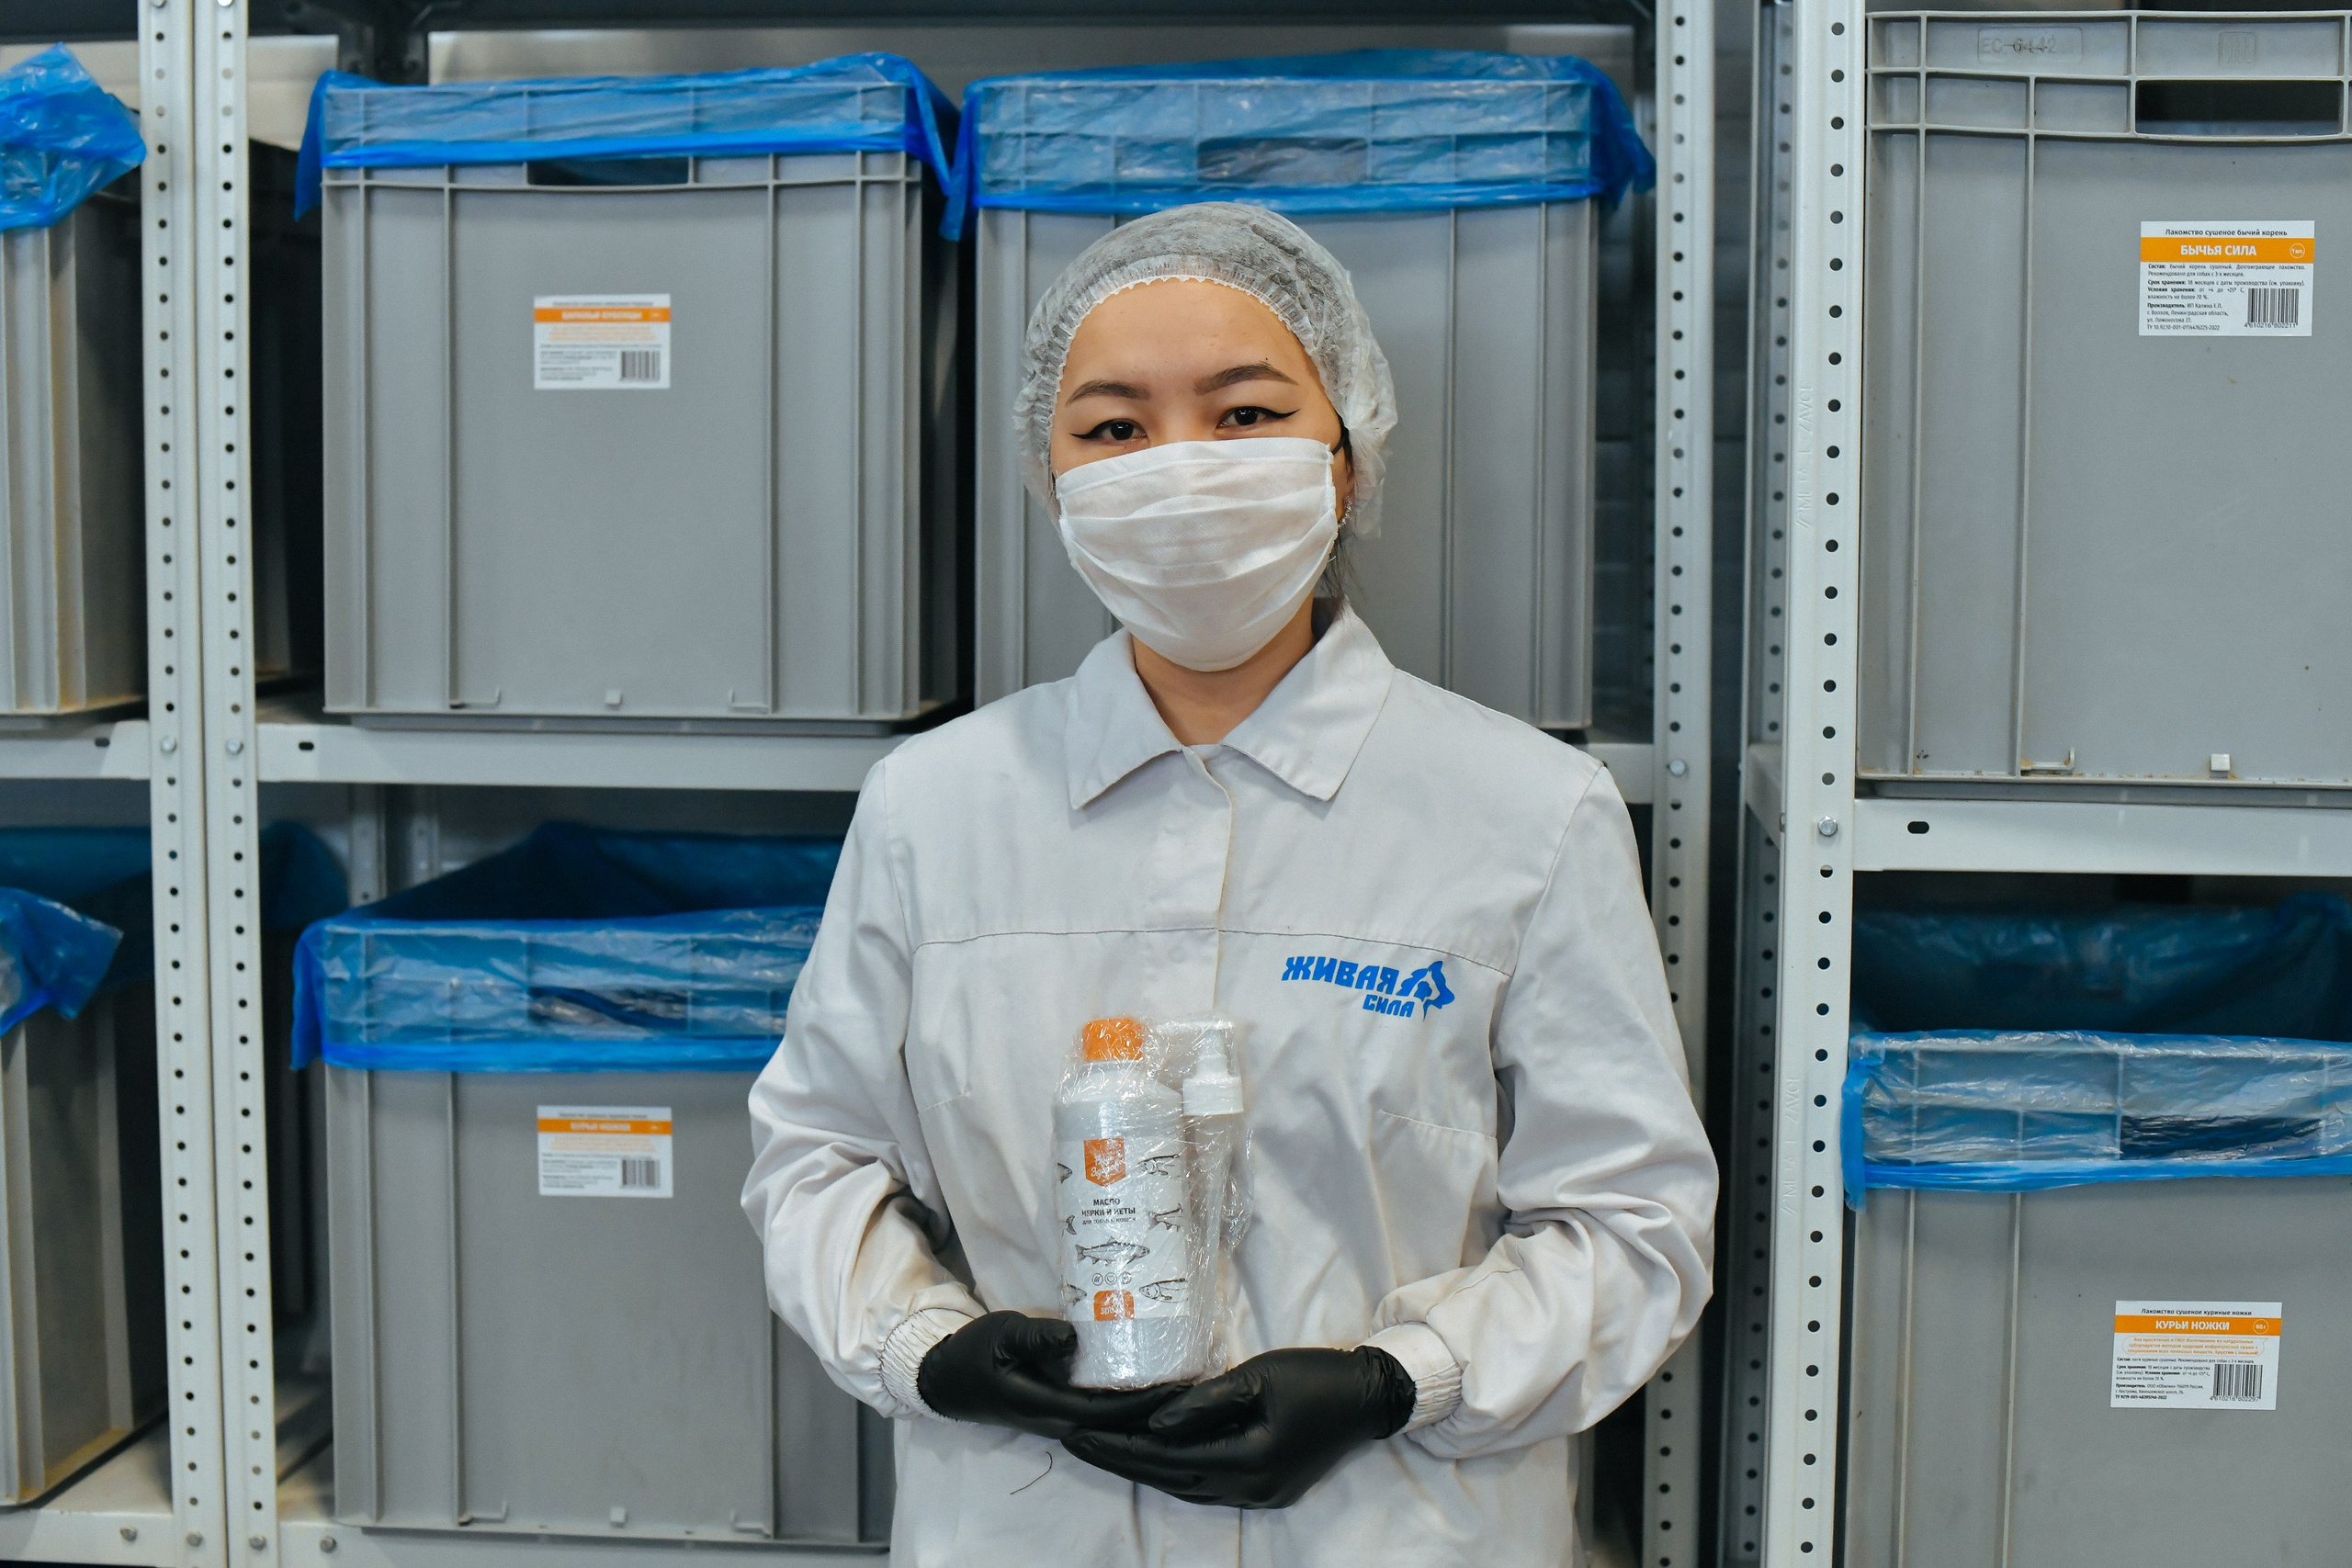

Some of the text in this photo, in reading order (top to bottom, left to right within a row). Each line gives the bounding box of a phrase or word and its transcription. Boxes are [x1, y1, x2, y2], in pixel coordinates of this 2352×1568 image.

[2180, 244, 2257, 256] БЫЧЬЯ СИЛА
[1281, 956, 1399, 995] ЖИВАЯ
[1363, 994, 1415, 1018] СИЛА
[2156, 1321, 2230, 1330] КУРЬИ НОЖКИ
